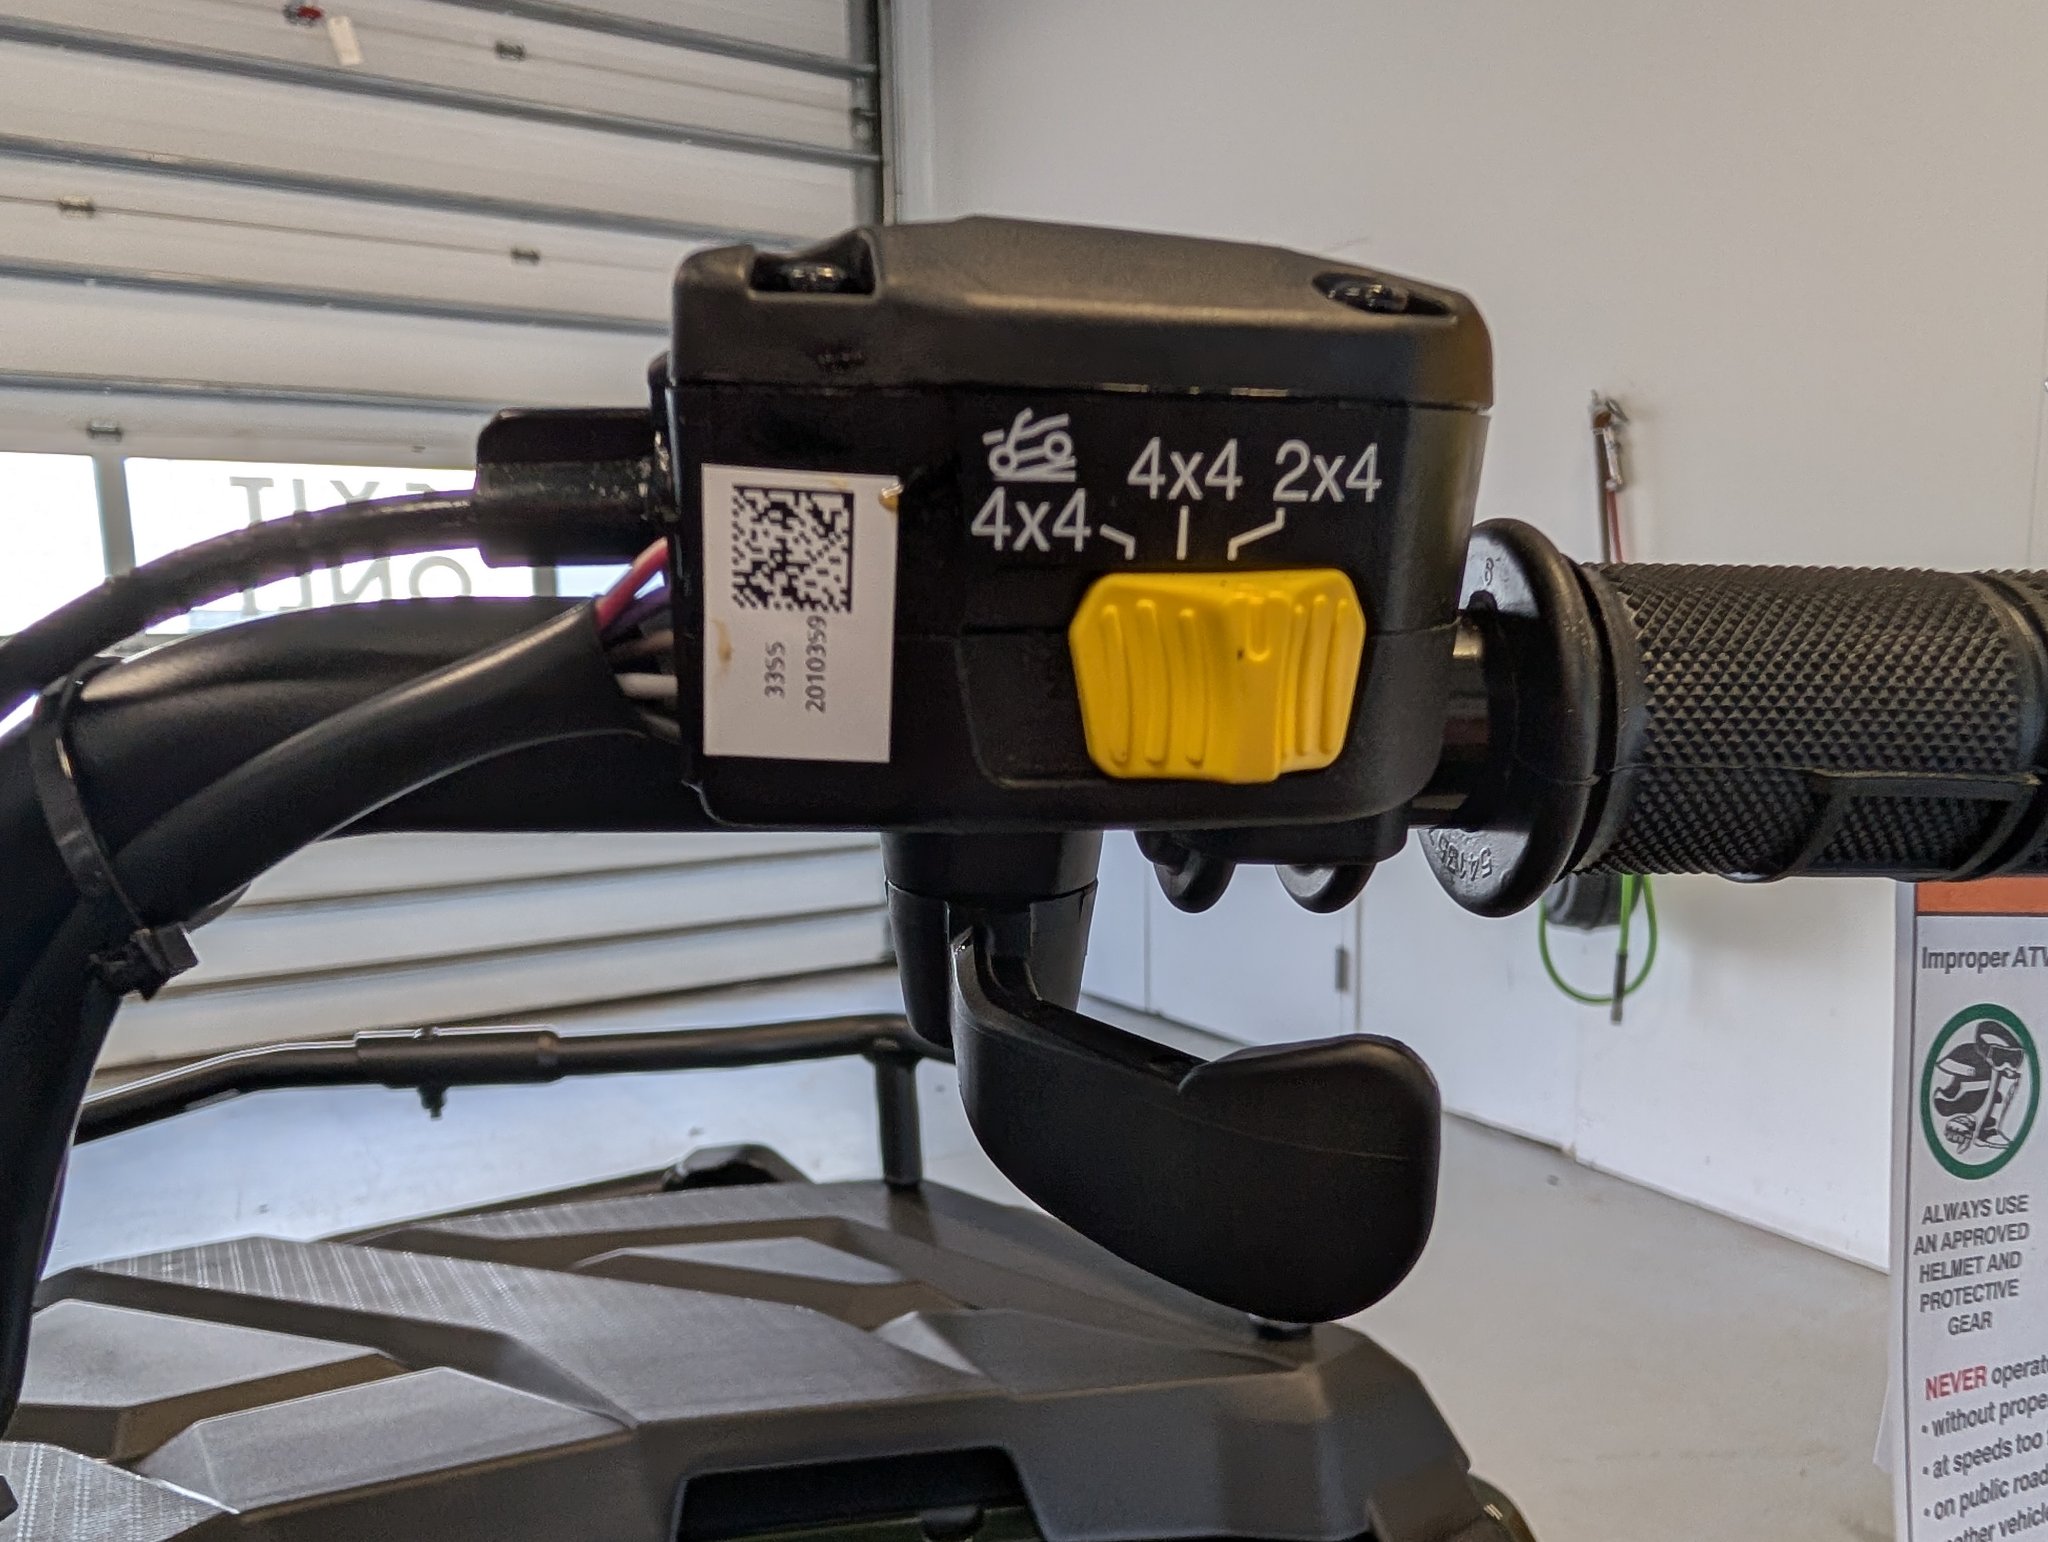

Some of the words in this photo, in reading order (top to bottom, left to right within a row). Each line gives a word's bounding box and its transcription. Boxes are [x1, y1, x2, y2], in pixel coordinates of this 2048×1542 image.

[1127, 436, 1243, 500] 4x4
[1273, 439, 1382, 502] 2x4
[971, 486, 1091, 552] 4x4
[805, 615, 827, 714] 2010359
[1921, 946, 2010, 975] Improper
[1921, 1198, 1993, 1225] ALWAYS
[1995, 1194, 2030, 1216] USE
[1913, 1233, 1938, 1256] AN
[1940, 1222, 2031, 1252] APPROVED
[1919, 1255, 1986, 1284] HELMET
[1986, 1250, 2023, 1273] AND
[1919, 1278, 2020, 1313] PROTECTIVE
[1947, 1310, 1994, 1336] GEAR
[1925, 1365, 1987, 1401] NEVER
[1991, 1354, 2048, 1389] operat
[1931, 1401, 1996, 1437] without
[1999, 1393, 2048, 1426] prope
[1932, 1454, 1951, 1479] at
[1953, 1437, 2014, 1476] speeds
[2015, 1432, 2044, 1454] too
[1933, 1498, 1957, 1520] on
[1959, 1478, 2010, 1518] public
[1998, 1502, 2048, 1537] vehicl
